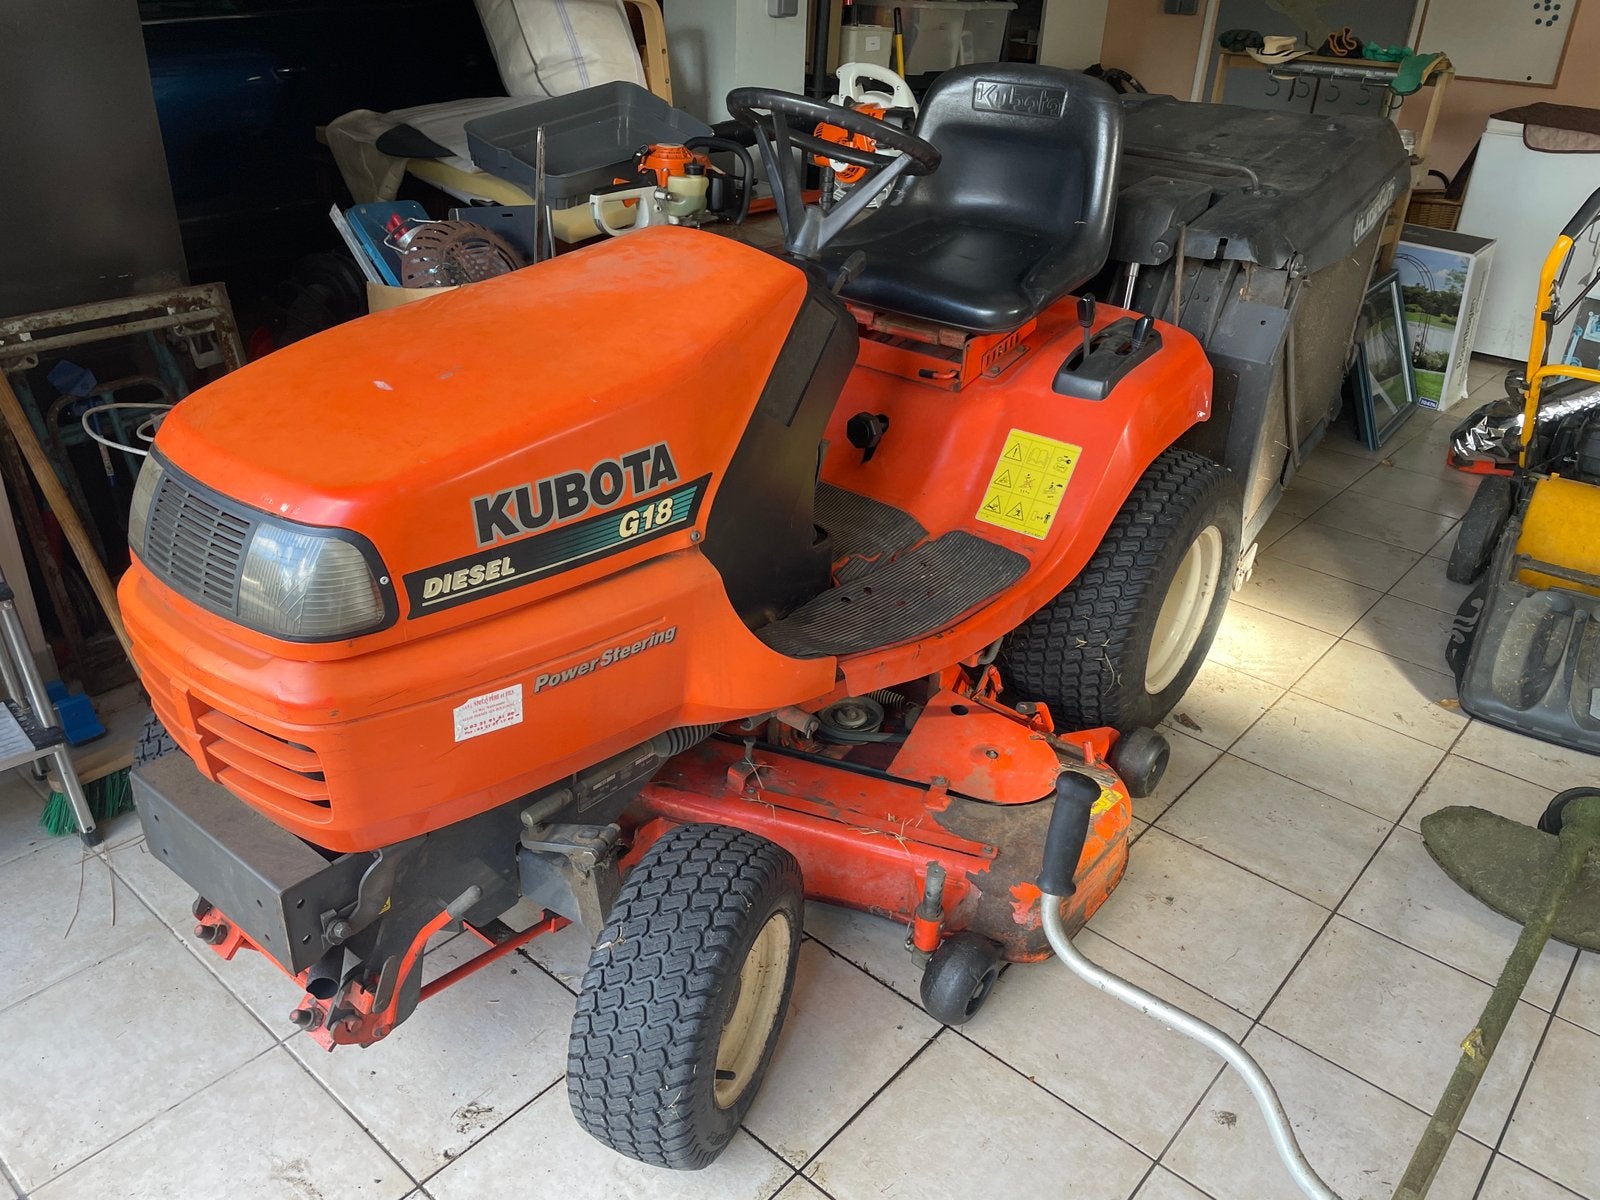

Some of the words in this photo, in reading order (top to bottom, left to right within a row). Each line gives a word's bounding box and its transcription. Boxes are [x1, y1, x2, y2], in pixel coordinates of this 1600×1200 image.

[976, 83, 1060, 116] Kubota
[472, 441, 678, 547] KUBOTA
[618, 498, 673, 538] G18
[423, 556, 515, 599] DIESEL
